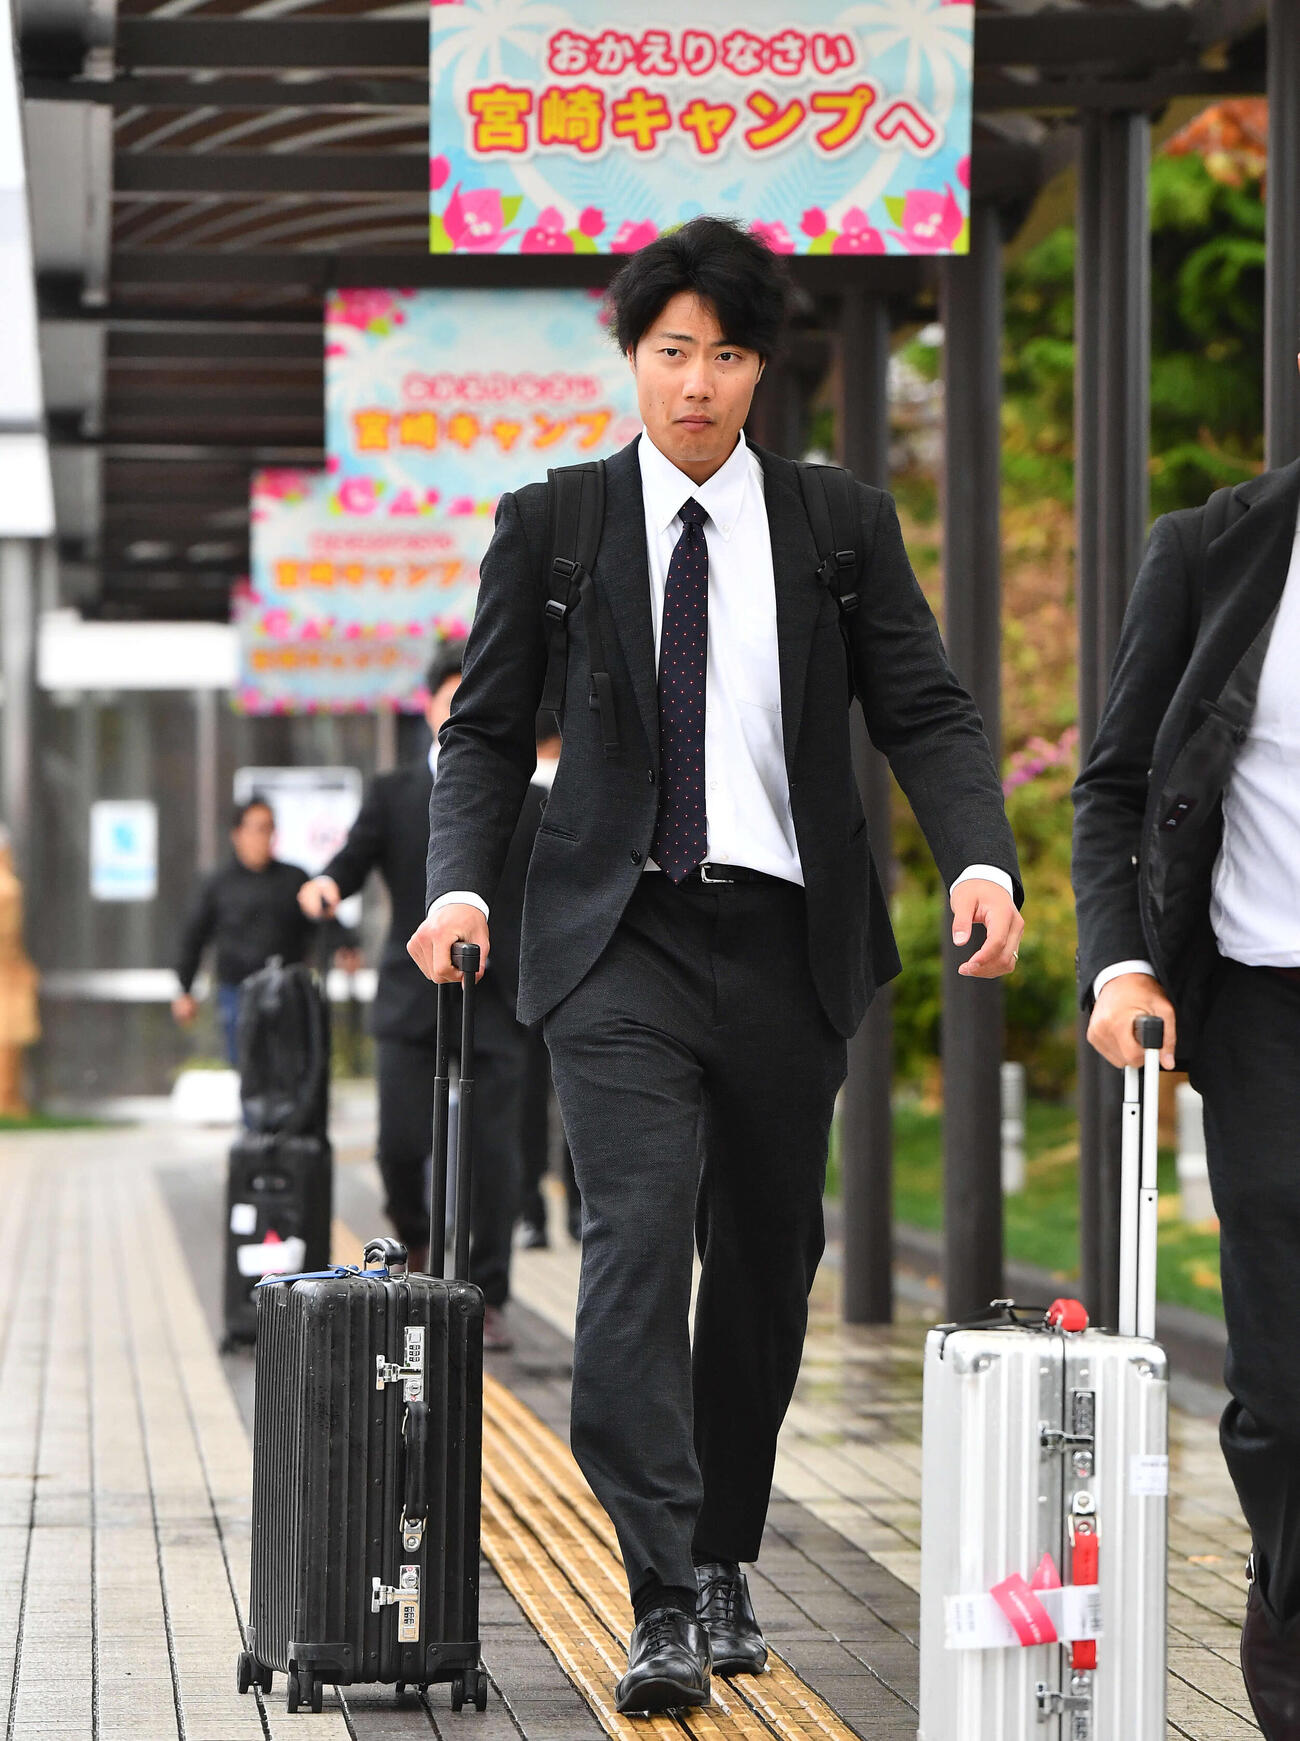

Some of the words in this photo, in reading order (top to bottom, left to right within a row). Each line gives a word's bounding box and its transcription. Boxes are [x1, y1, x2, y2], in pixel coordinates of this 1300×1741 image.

[549, 30, 856, 75] おかえりなさい
[468, 85, 936, 153] 宮崎キャンプへ
